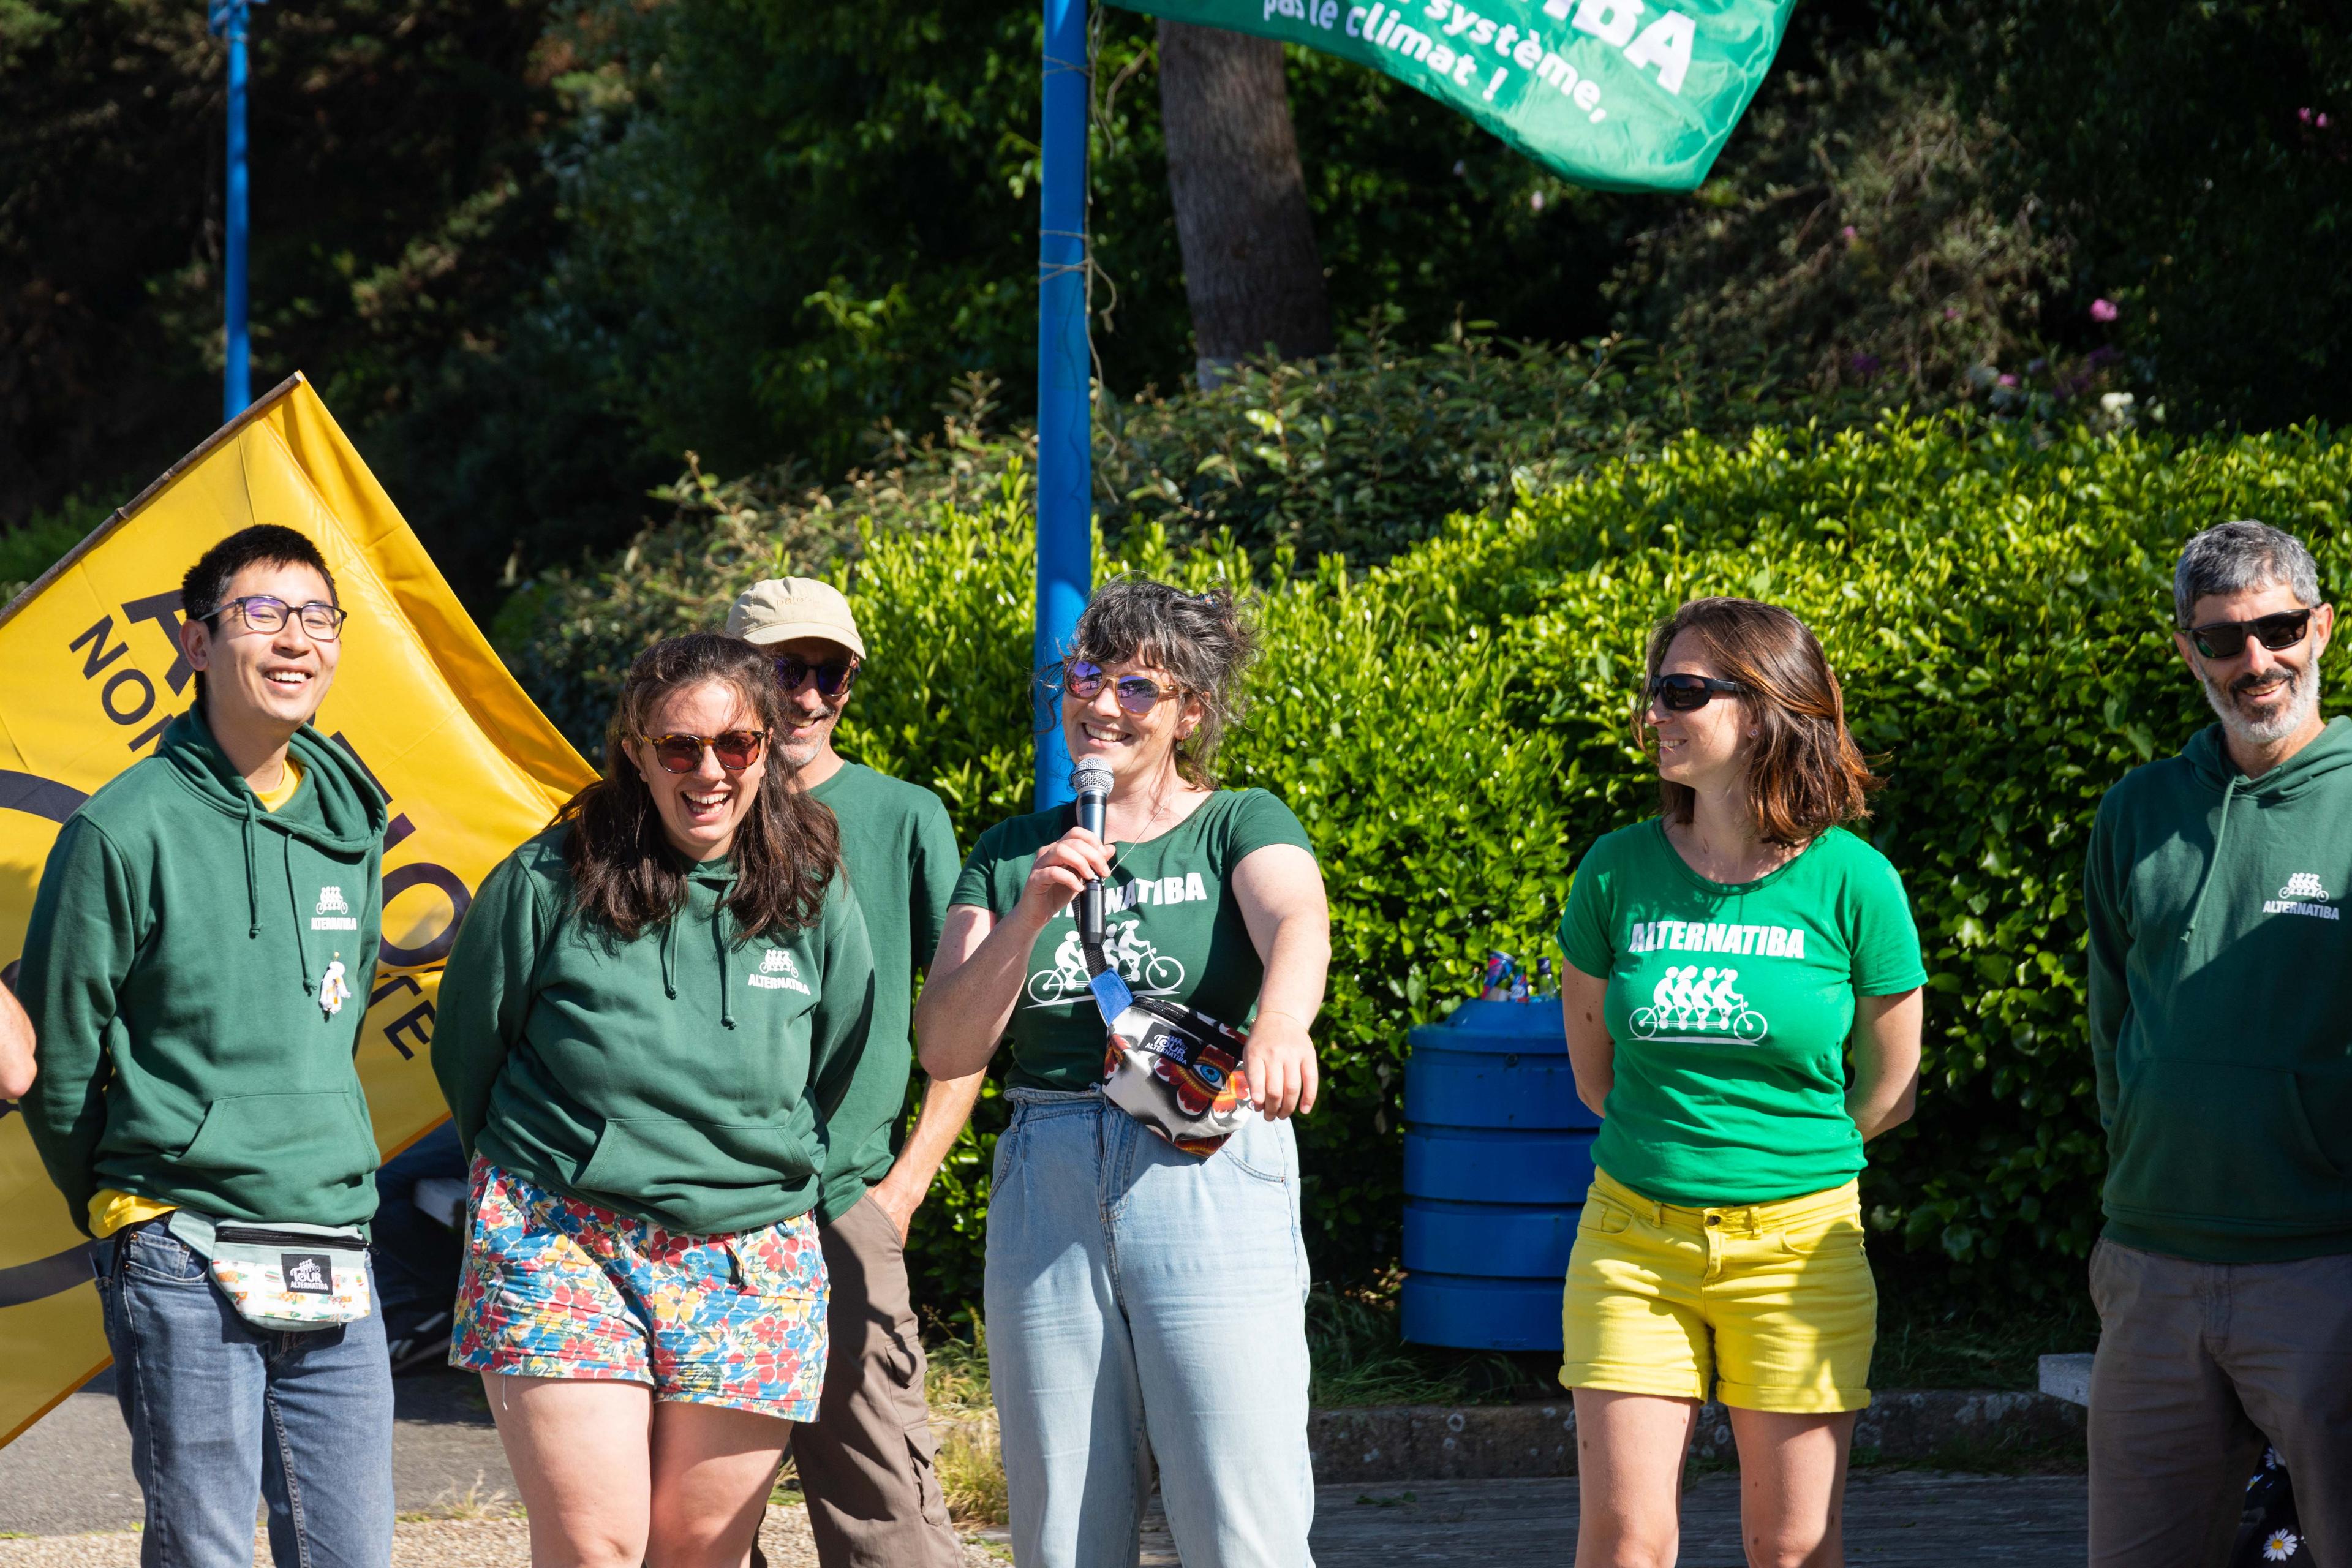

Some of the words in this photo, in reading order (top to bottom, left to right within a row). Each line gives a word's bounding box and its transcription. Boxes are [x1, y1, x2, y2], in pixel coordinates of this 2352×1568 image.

[1310, 0, 1339, 31] le
[1345, 2, 1477, 86] climat
[1482, 66, 1509, 102] !
[1423, 0, 1607, 123] système,
[1052, 872, 1207, 918] NATIBA
[2262, 900, 2340, 921] ALTERNATIBA
[310, 916, 357, 930] ALTERNATIBA
[1627, 920, 1805, 959] ALTERNATIBA
[748, 973, 811, 996] ALTERNATIBA
[1145, 1042, 1187, 1065] ALTERNATIBA
[1153, 1034, 1186, 1058] TOUR
[290, 1267, 323, 1283] TOUR
[290, 1281, 329, 1291] ALTERNATIBA
